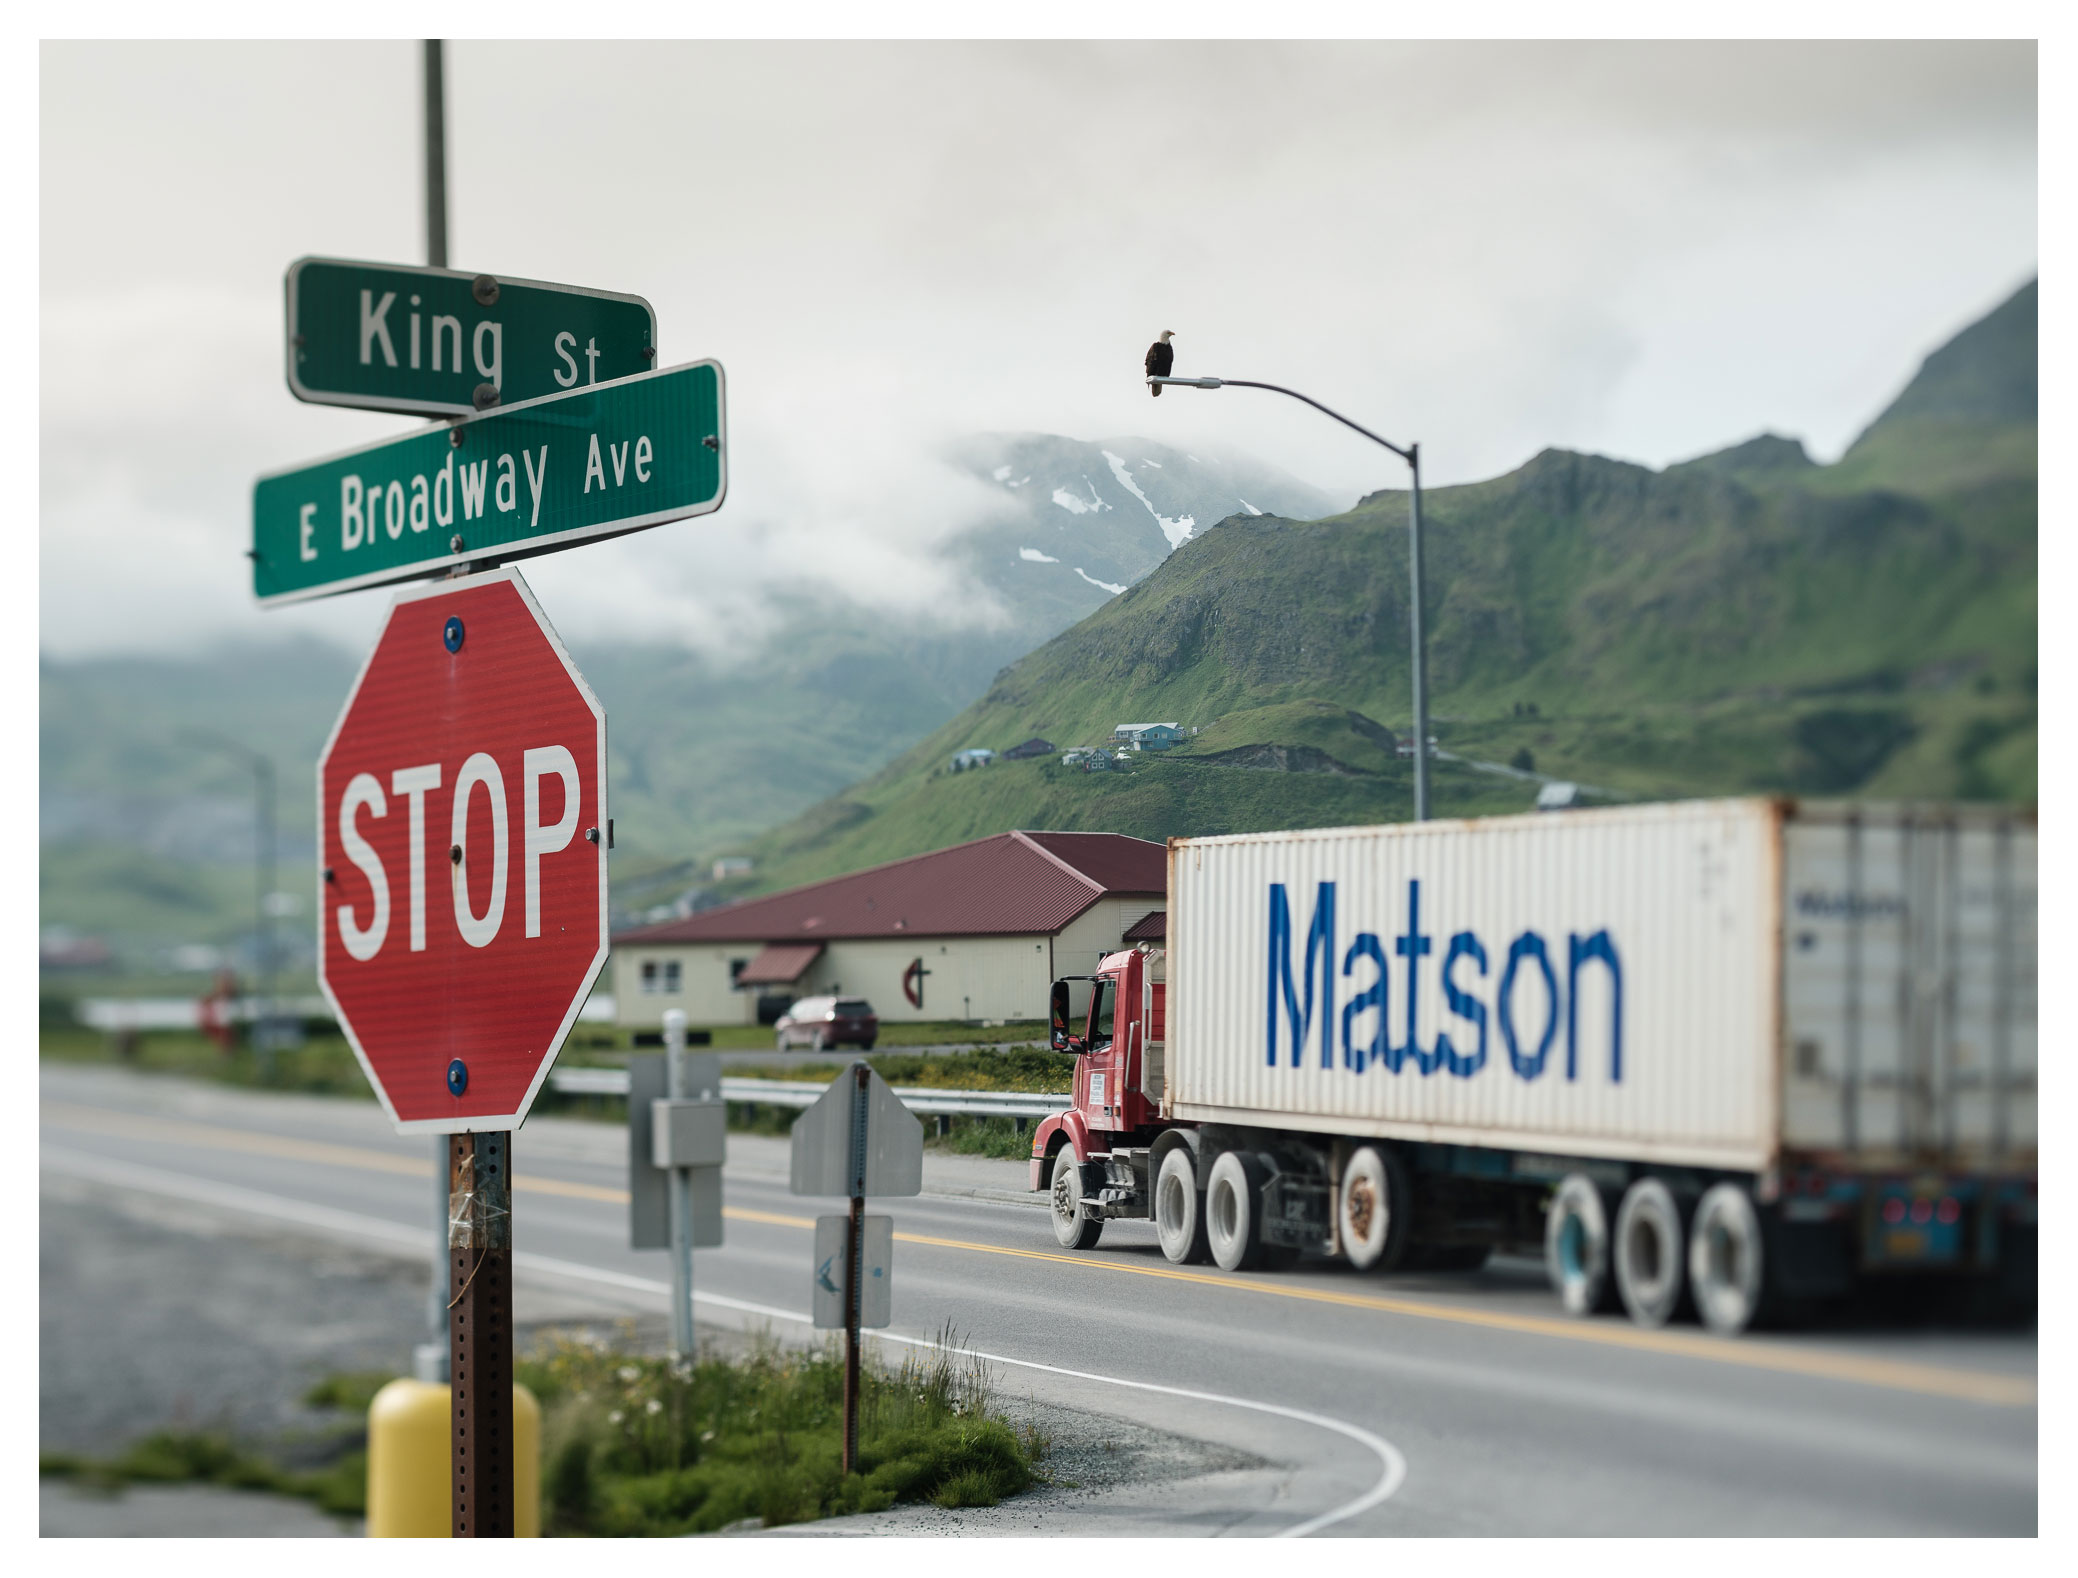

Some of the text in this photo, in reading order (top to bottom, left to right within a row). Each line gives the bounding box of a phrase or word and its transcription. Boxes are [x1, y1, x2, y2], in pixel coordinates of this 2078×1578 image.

[359, 289, 601, 394] King St
[301, 433, 653, 562] E Broadway Ave
[337, 744, 581, 962] STOP
[1266, 878, 1623, 1083] Matson
